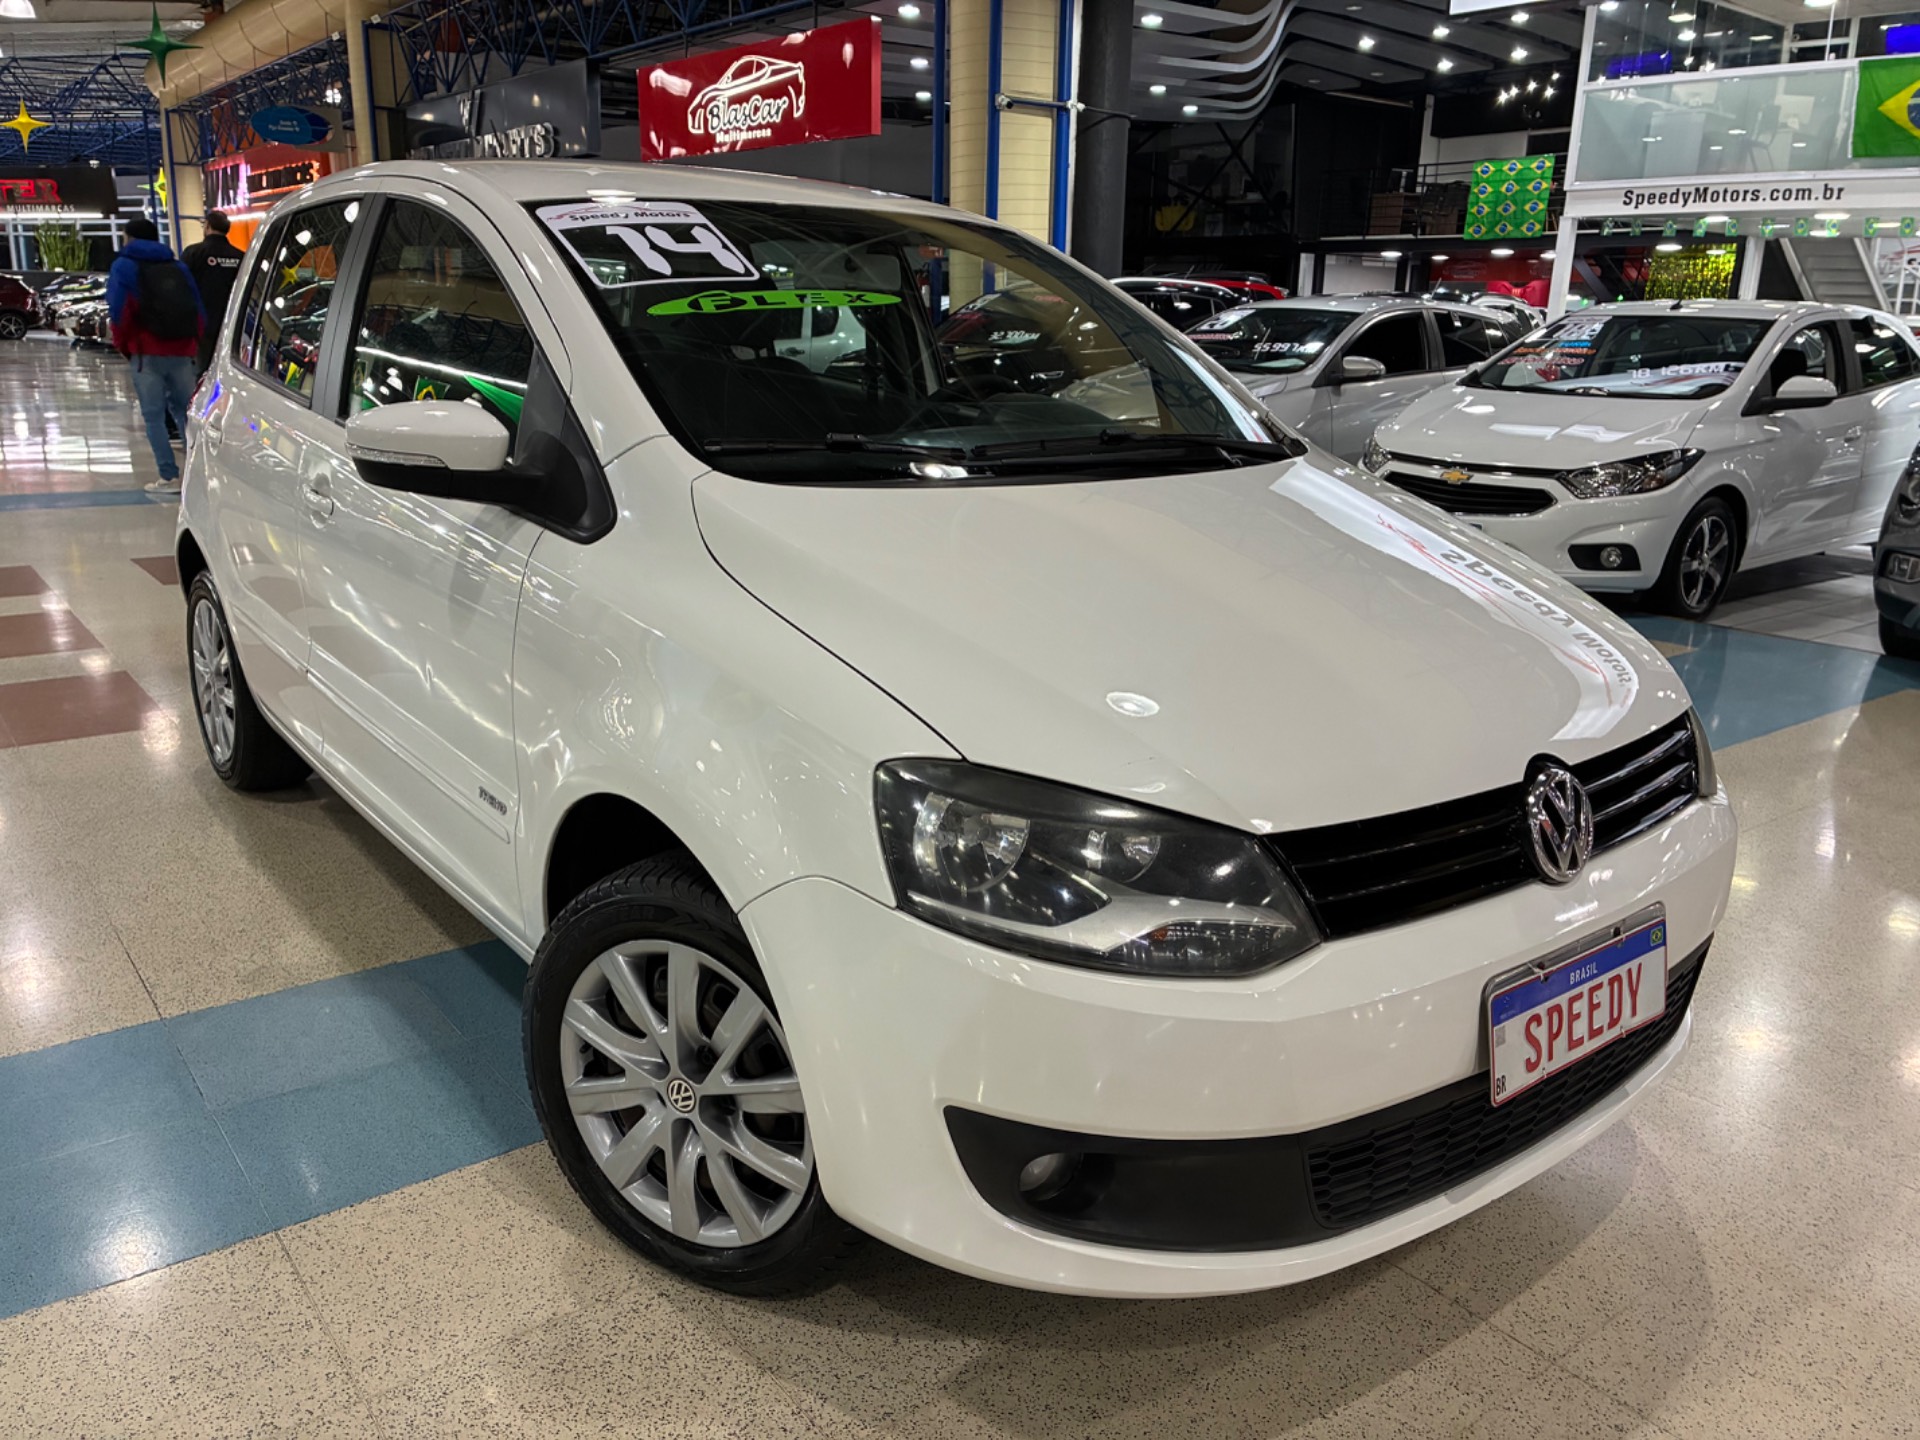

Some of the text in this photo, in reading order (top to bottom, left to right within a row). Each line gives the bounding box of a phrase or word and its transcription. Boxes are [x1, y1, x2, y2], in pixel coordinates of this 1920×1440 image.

[707, 96, 789, 133] BlasCar
[1622, 183, 1845, 209] SpeedyMotors.com.br
[6, 204, 75, 213] MULTIMARCAS
[568, 210, 691, 222] Speedy Motors
[606, 225, 746, 276] 14
[697, 291, 874, 312] FLEX
[1569, 961, 1598, 985] BRASIL
[1524, 961, 1643, 1074] SPEEDY
[1496, 1074, 1507, 1097] BR
